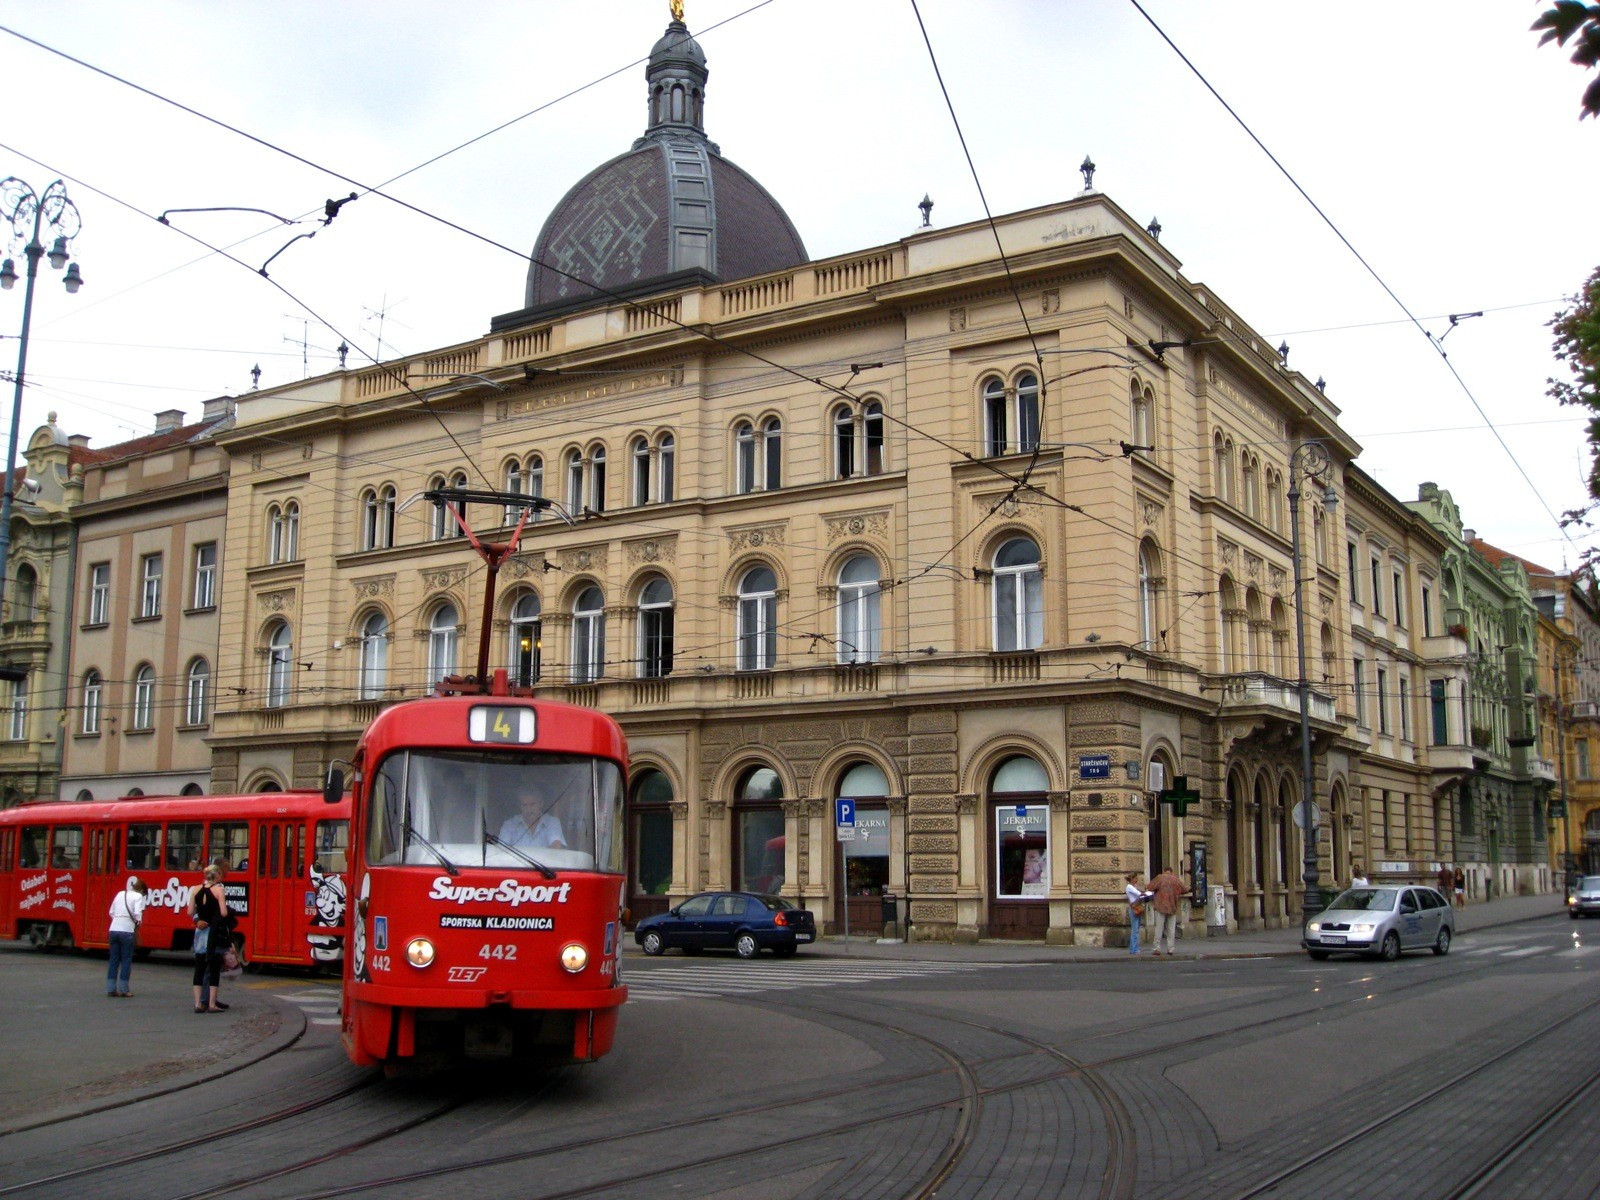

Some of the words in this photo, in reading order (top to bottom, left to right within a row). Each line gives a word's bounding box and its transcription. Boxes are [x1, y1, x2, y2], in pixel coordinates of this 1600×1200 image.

[492, 710, 511, 738] 4
[841, 804, 850, 822] P
[428, 876, 571, 907] SuperSport
[440, 917, 482, 928] SPORTSKA
[485, 917, 553, 929] KLADIONICA
[478, 944, 517, 960] 442
[372, 954, 391, 972] 442
[448, 966, 488, 982] ZET
